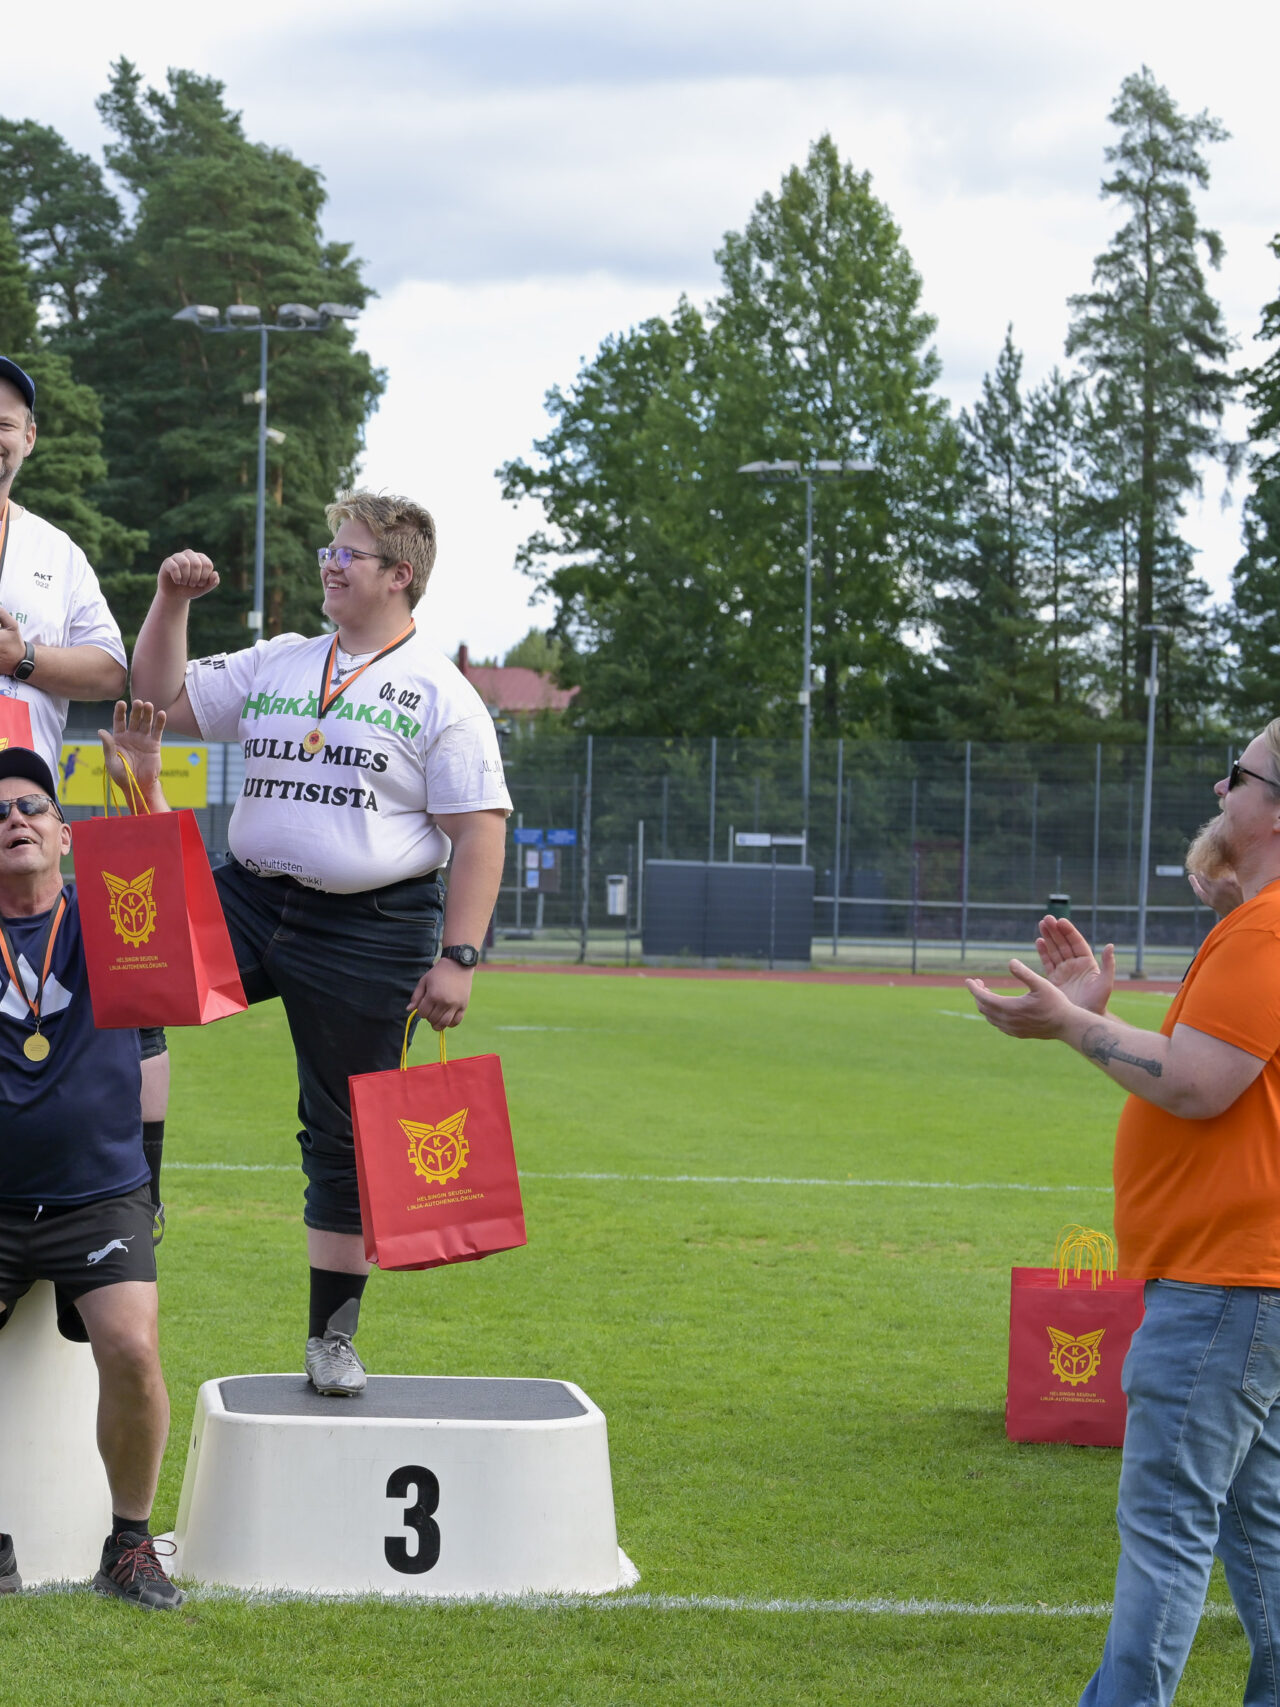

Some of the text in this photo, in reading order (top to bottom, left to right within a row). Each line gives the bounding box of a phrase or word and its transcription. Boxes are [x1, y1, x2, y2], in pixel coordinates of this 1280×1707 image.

[33, 571, 53, 581] AKT
[35, 580, 50, 589] 022
[379, 682, 422, 711] Os. 022
[245, 738, 389, 773] HULLU MIES
[244, 778, 378, 812] UITTISISTA
[260, 859, 303, 873] Huittisten
[416, 1188, 472, 1202] HELSINGIN SEUDUN
[384, 1465, 441, 1575] 3
